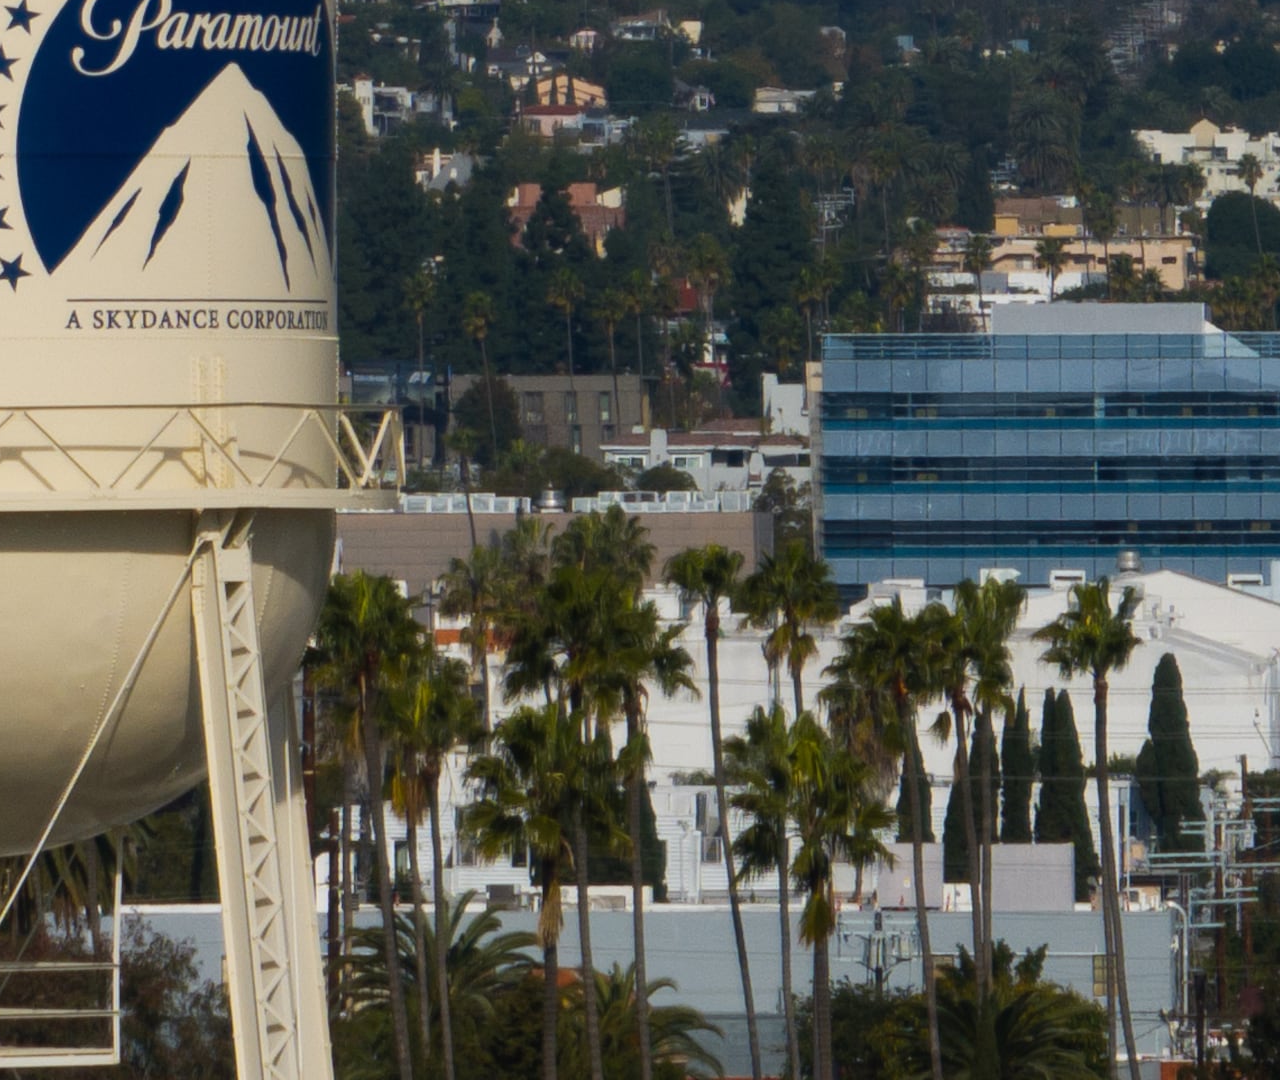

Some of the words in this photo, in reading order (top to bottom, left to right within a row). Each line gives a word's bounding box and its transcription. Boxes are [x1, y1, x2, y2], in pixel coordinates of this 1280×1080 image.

[65, 309, 82, 329] A
[93, 309, 220, 329] SKYDANCE
[226, 309, 328, 331] CORPORATION
